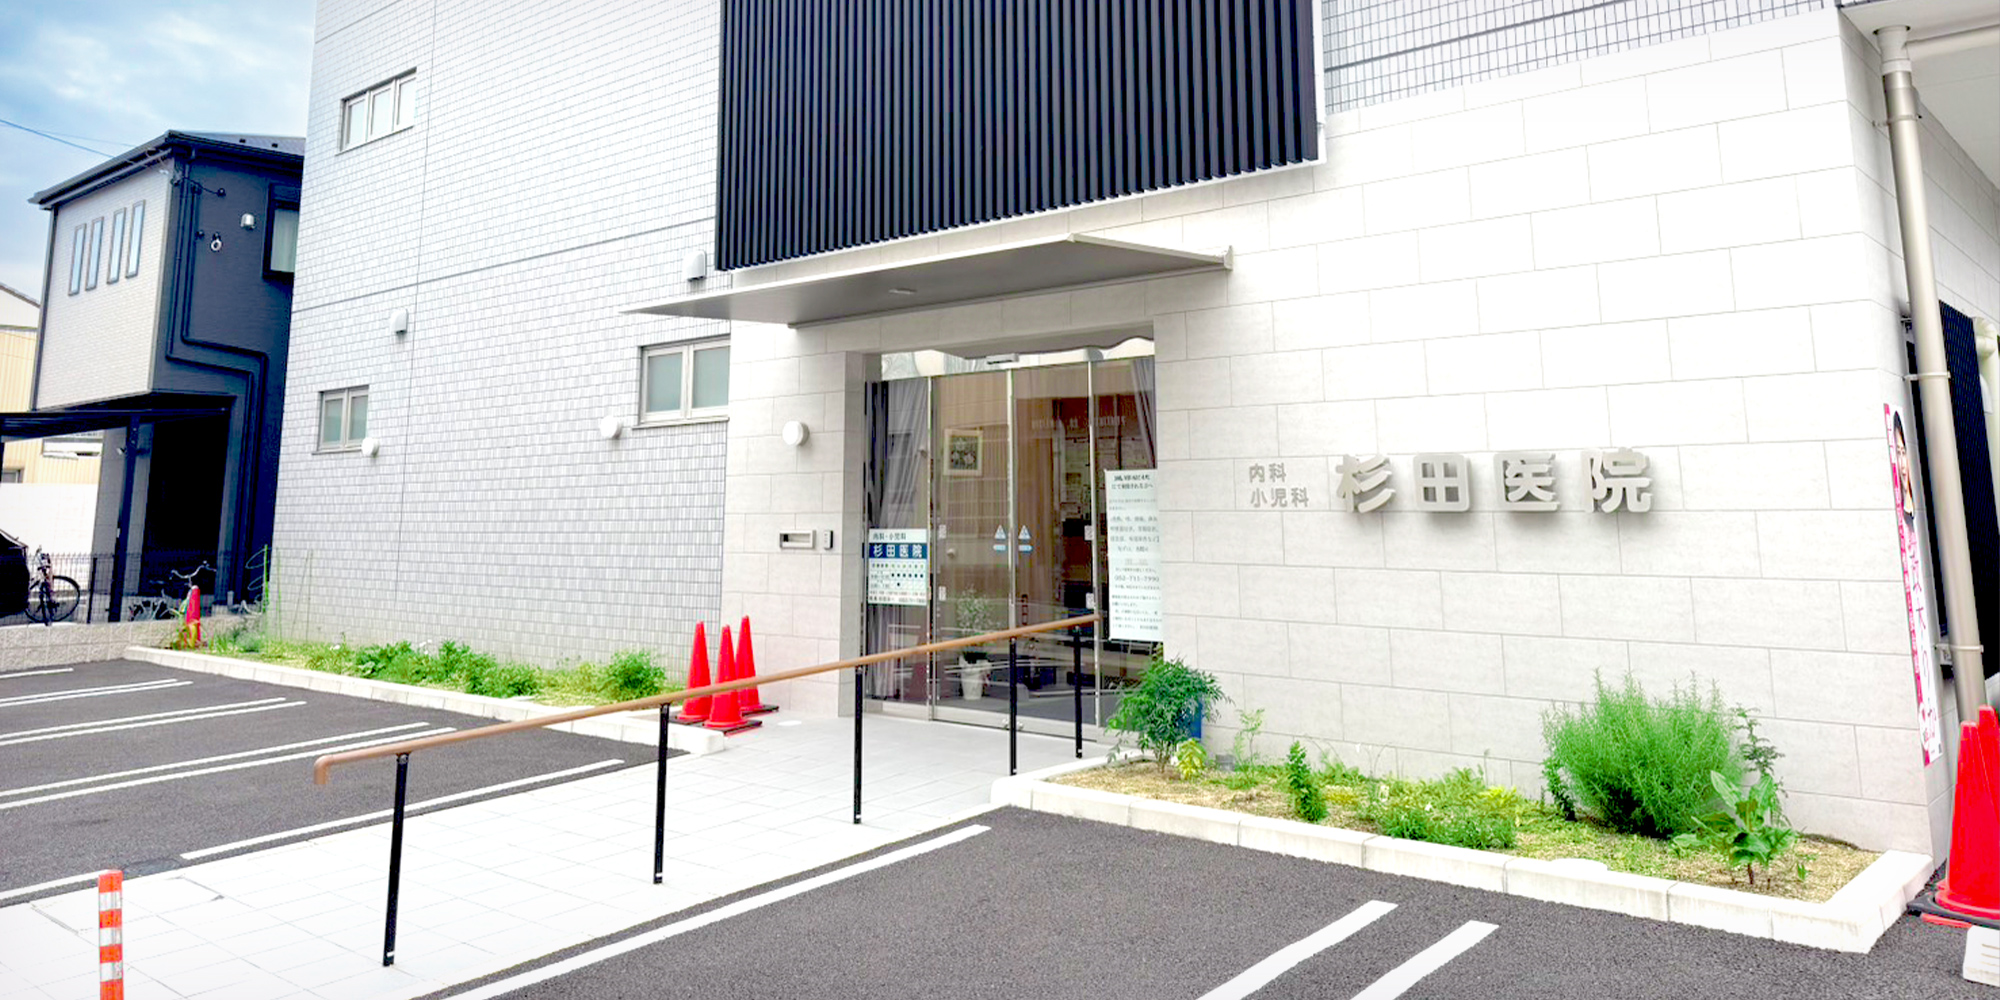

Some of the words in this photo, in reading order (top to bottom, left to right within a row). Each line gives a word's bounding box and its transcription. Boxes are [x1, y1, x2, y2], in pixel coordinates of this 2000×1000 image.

[1249, 462, 1287, 483] 内科
[1336, 447, 1655, 514] 杉田医院
[1250, 487, 1309, 507] 小児科
[873, 544, 922, 557] 杉田医院
